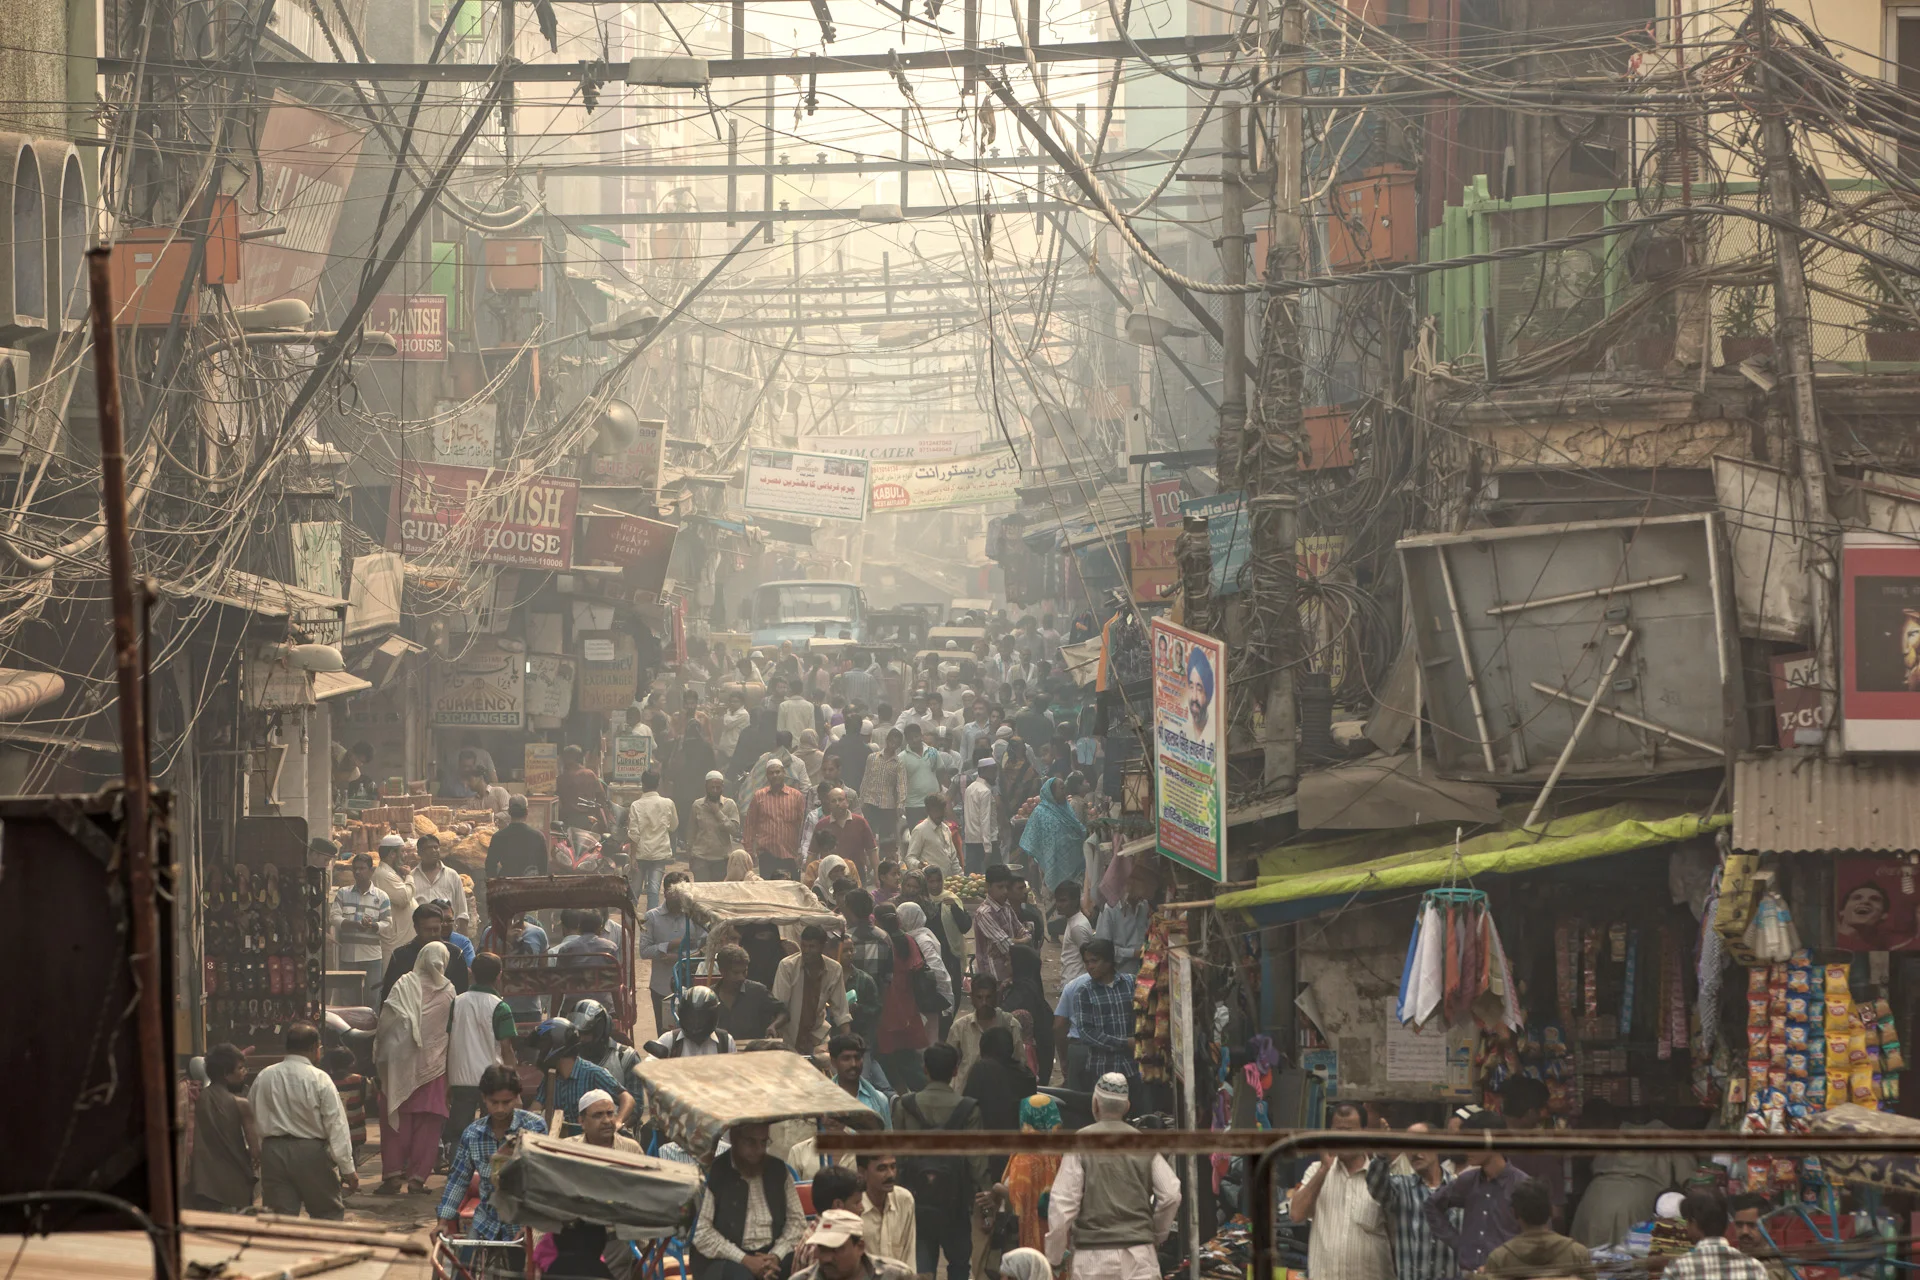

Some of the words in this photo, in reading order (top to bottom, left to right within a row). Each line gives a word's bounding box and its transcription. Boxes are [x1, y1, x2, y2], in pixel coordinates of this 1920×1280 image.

[389, 308, 441, 335] DANISH
[401, 339, 442, 352] HOUSE
[869, 447, 916, 459] CATER
[873, 486, 905, 500] KABULI
[465, 479, 565, 528] DANISH
[482, 528, 561, 555] HOUSE
[437, 698, 517, 712] CURRENCY
[437, 713, 519, 724] EXCHANGER
